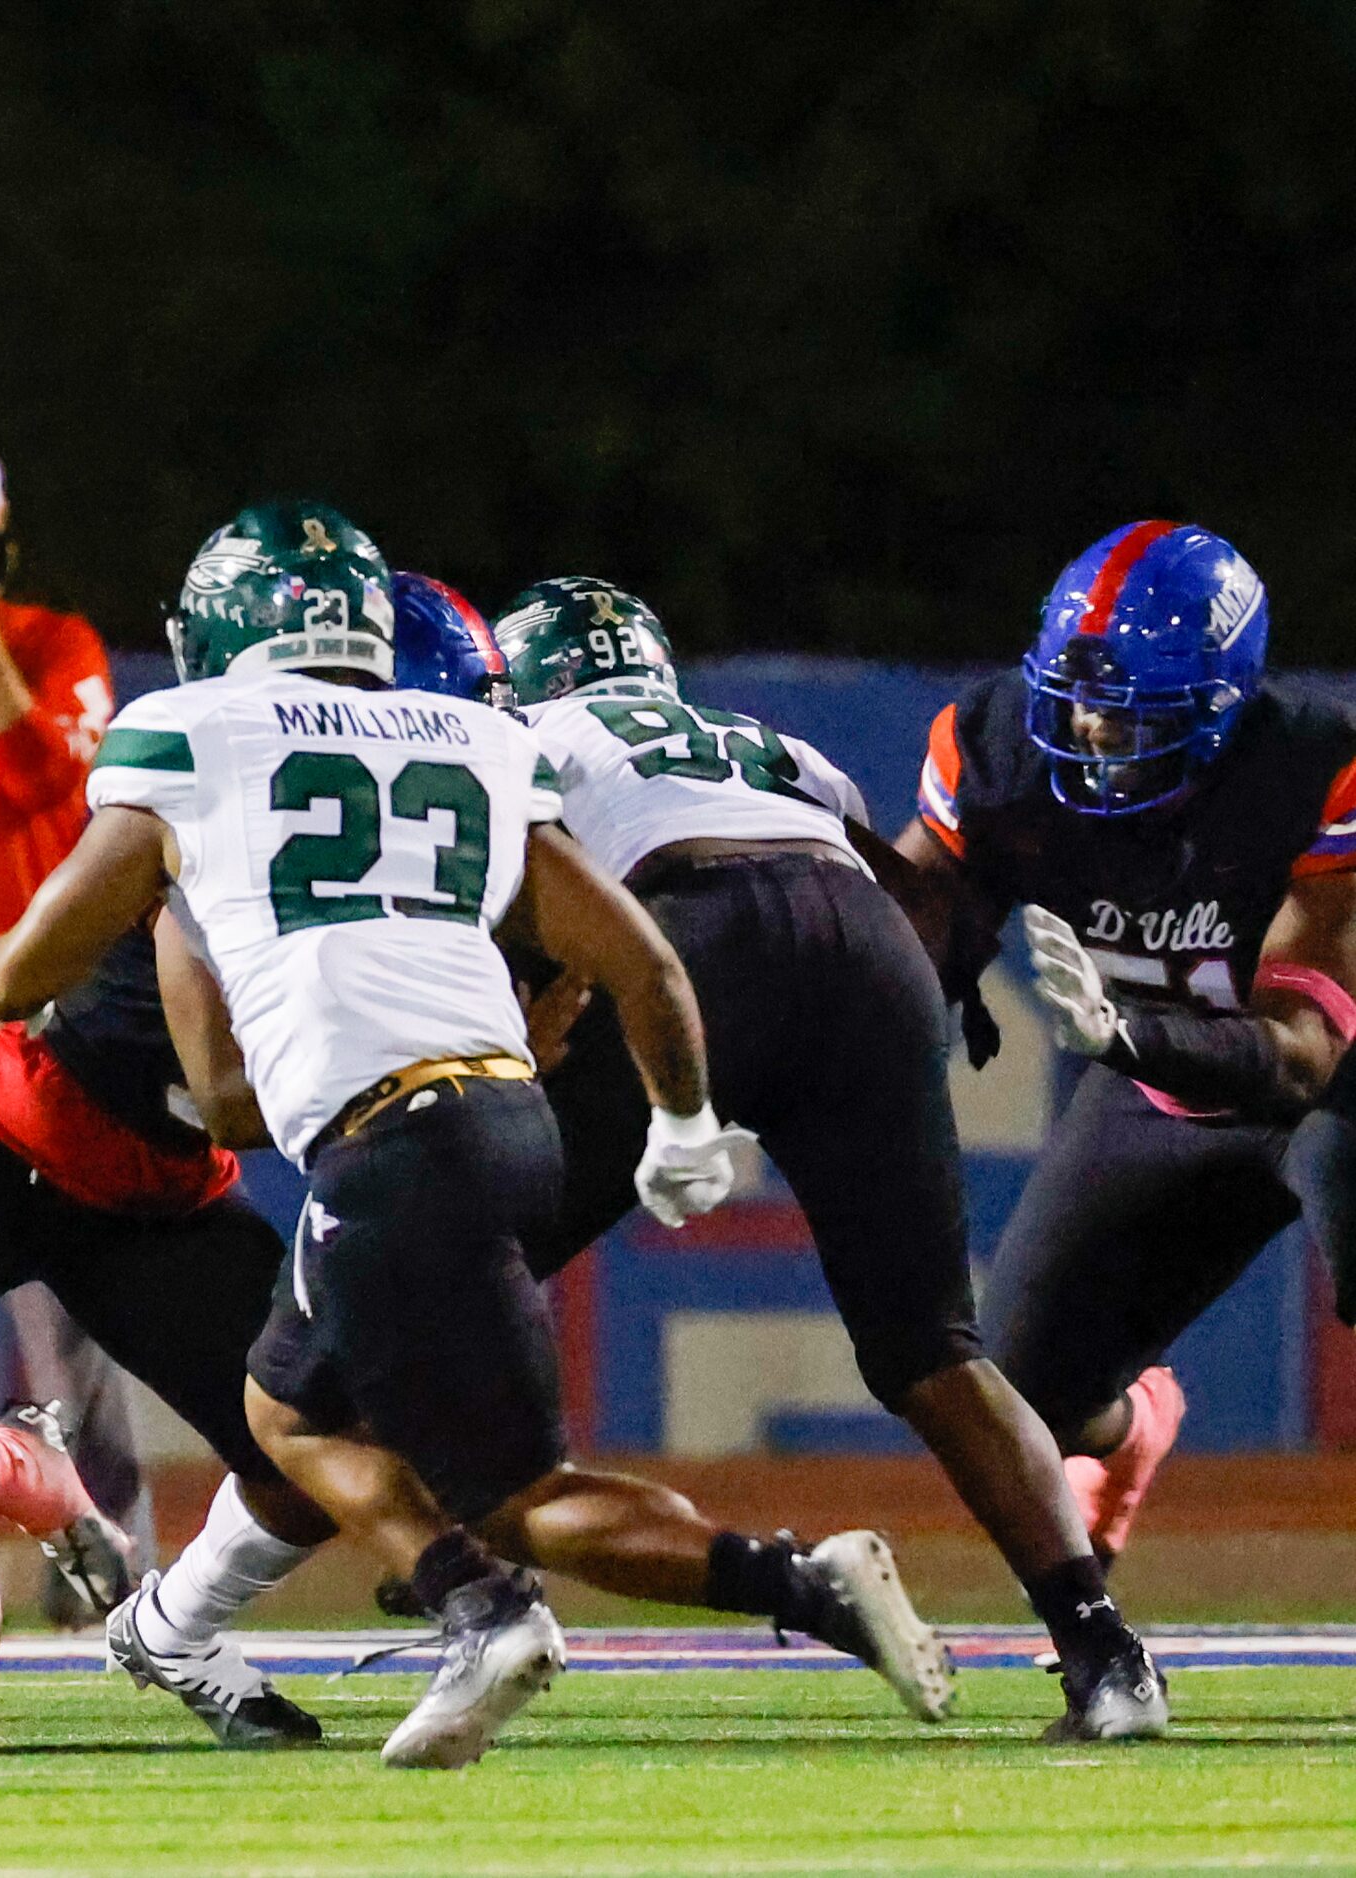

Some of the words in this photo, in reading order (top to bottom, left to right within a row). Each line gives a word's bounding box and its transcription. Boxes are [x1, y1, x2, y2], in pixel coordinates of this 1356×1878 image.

[303, 588, 348, 634] 23
[588, 627, 642, 670] 92
[273, 702, 471, 745] M.WILLIAMS
[586, 700, 802, 785] 92
[269, 750, 490, 937] 23
